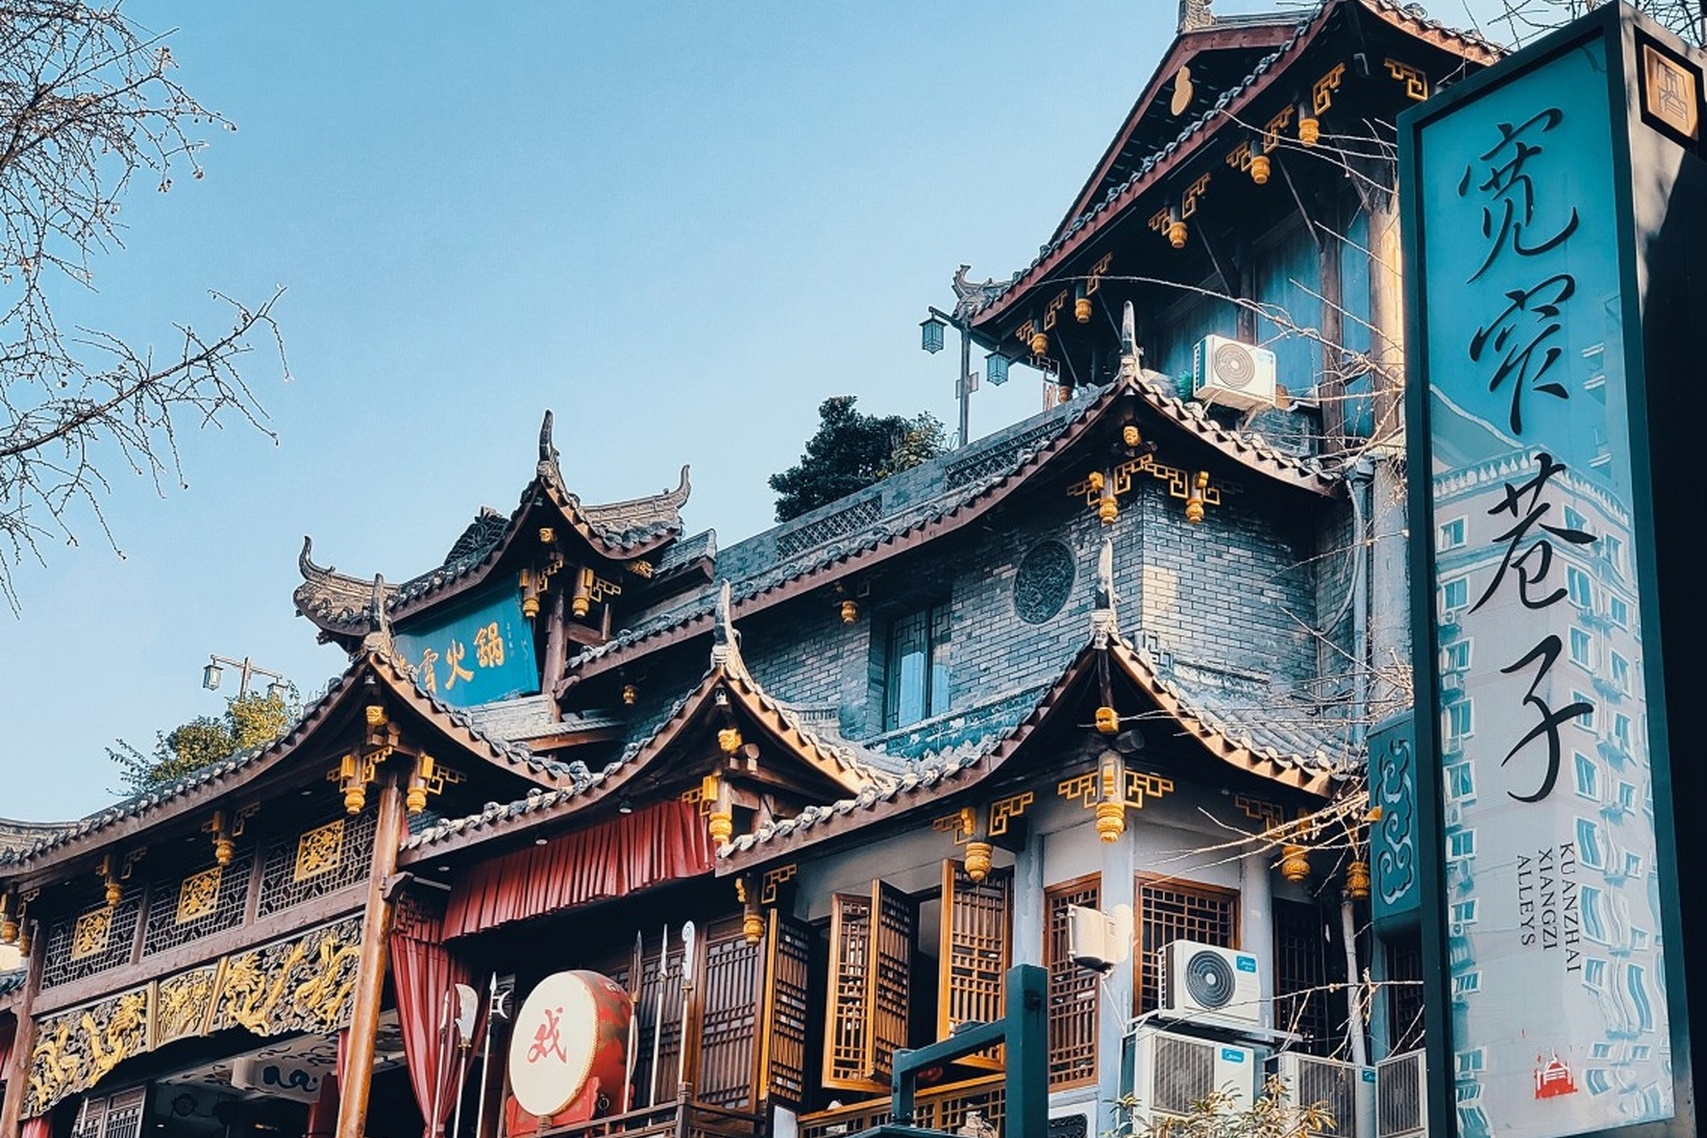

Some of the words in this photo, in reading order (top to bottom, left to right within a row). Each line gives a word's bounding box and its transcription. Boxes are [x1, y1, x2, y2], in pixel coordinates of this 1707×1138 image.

[1457, 106, 1599, 804] 宽窄巷子
[1517, 854, 1536, 946] ALLEYS
[1538, 846, 1558, 951] XIANGZI
[1560, 841, 1582, 973] KUANZHAI
